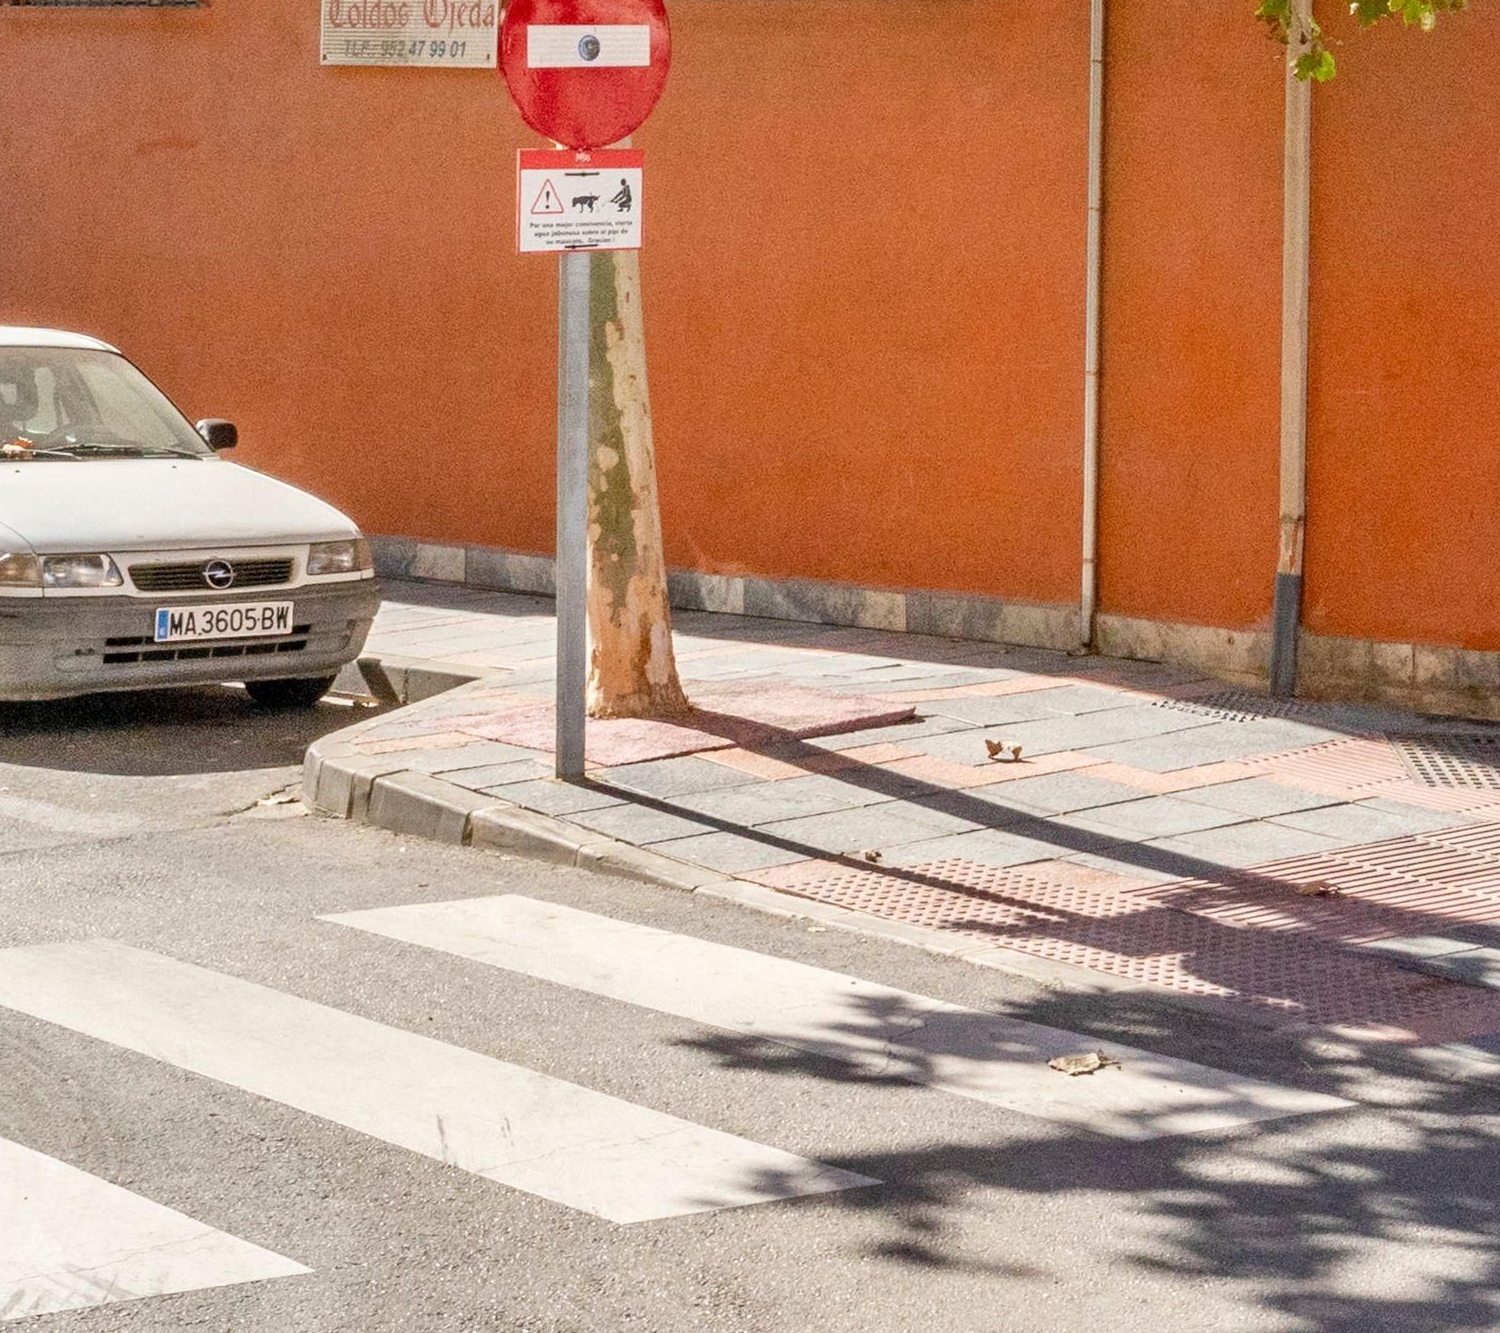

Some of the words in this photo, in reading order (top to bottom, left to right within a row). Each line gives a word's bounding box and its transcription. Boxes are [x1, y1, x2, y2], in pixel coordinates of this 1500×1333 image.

[408, 40, 426, 58] 47
[429, 40, 446, 58] 99
[450, 41, 467, 58] 01
